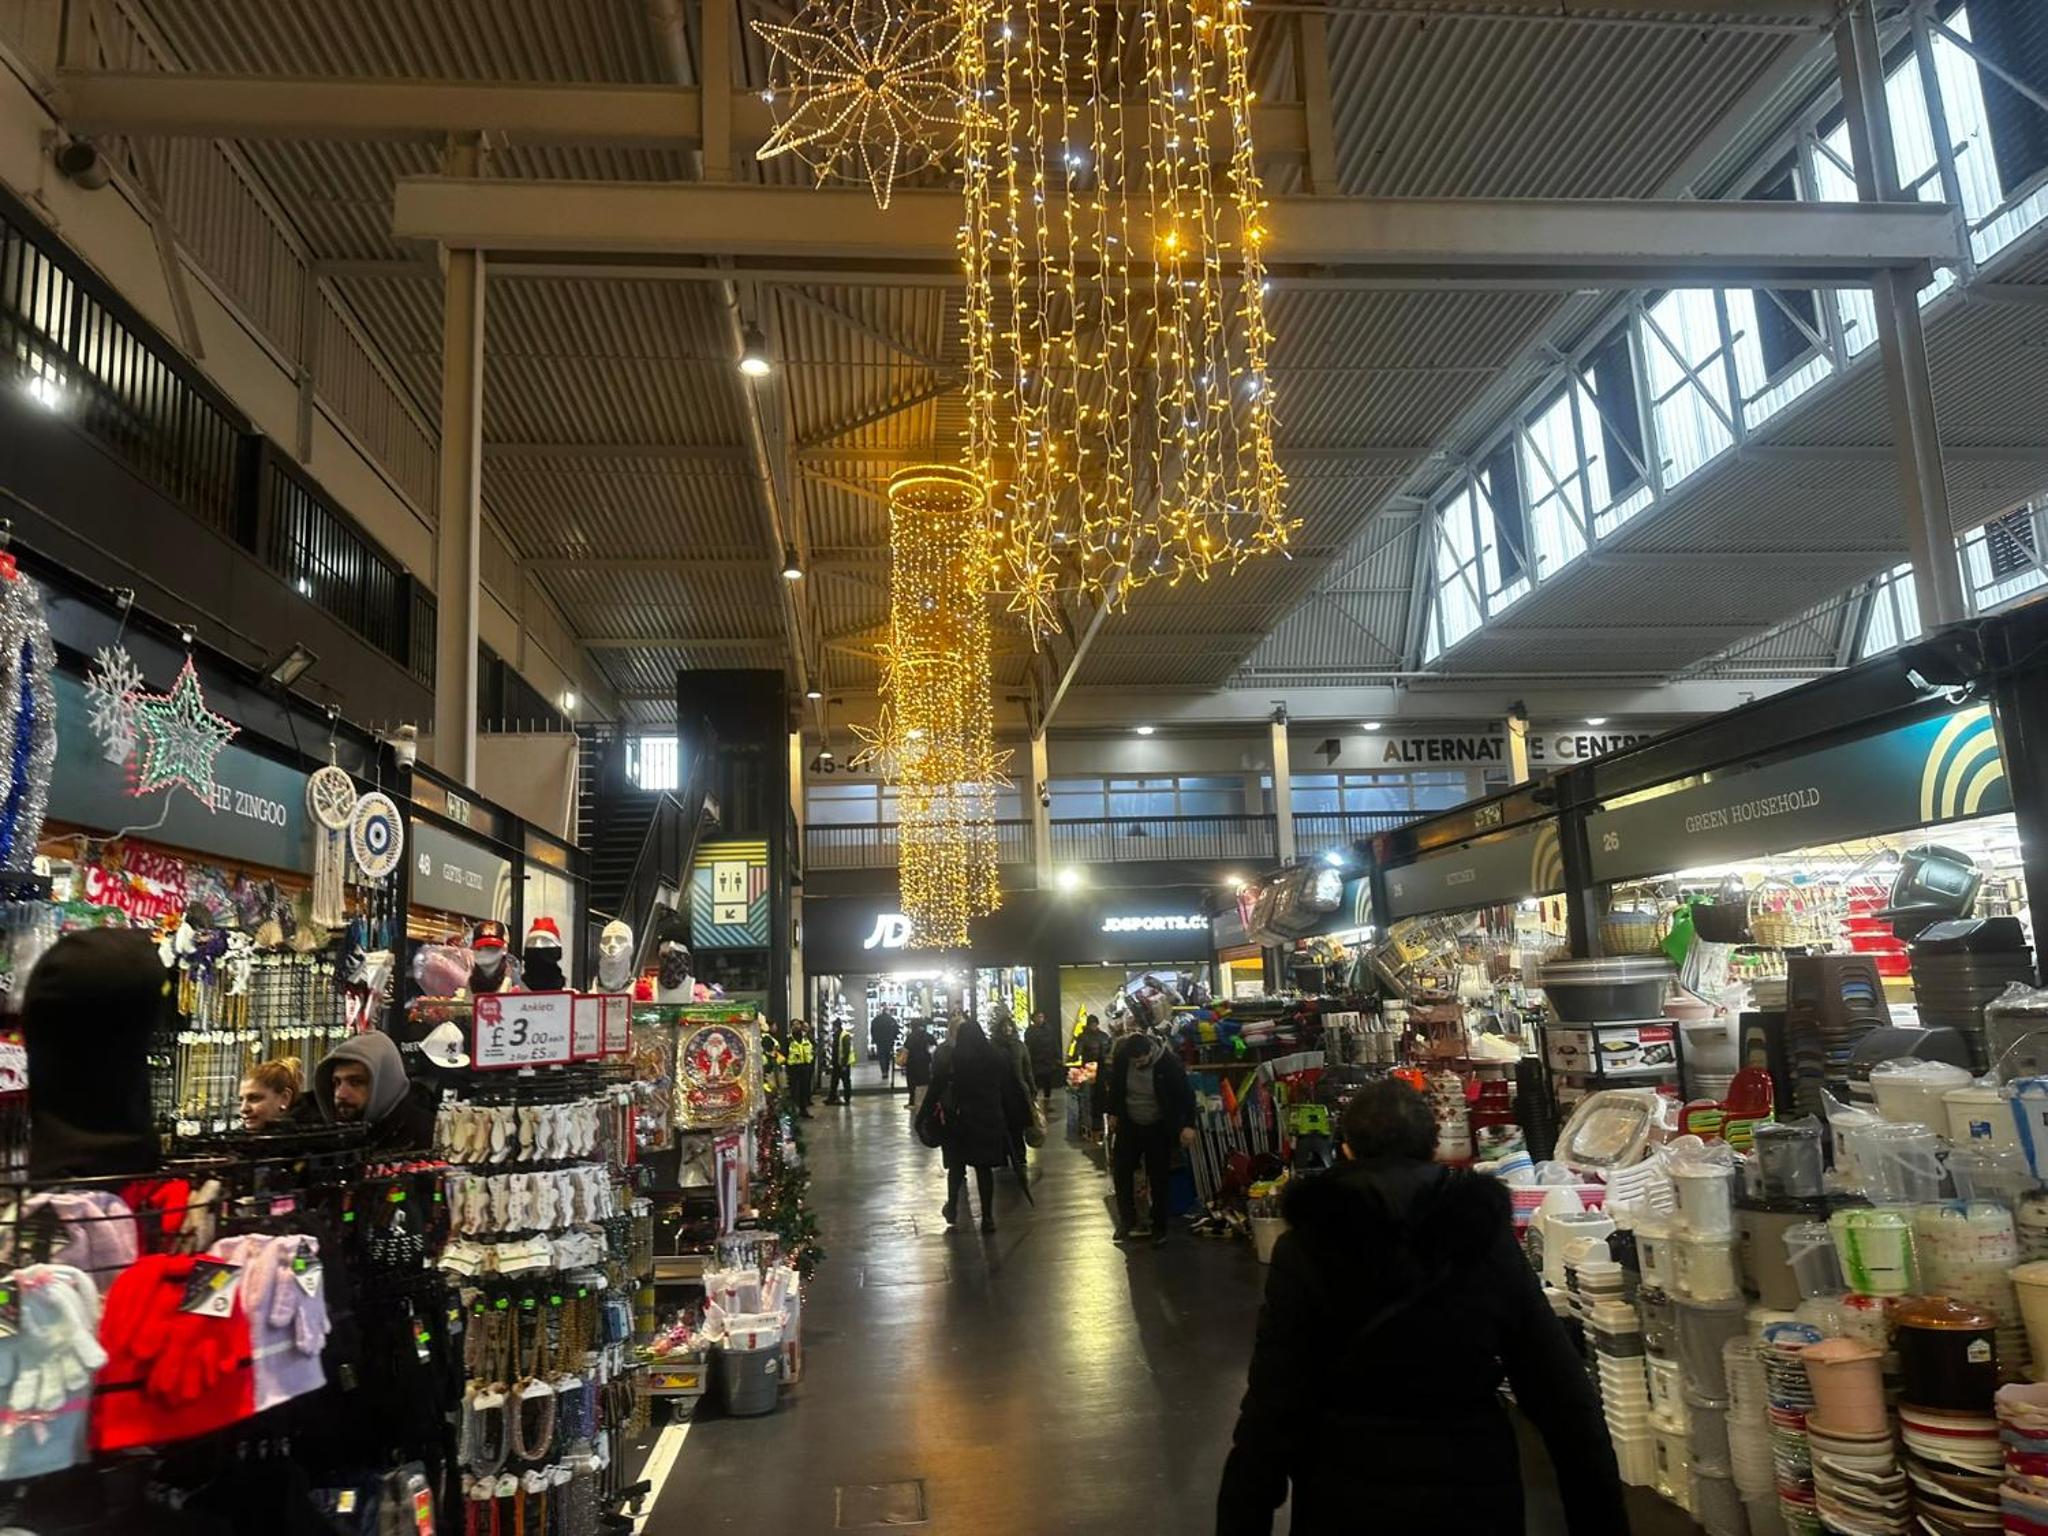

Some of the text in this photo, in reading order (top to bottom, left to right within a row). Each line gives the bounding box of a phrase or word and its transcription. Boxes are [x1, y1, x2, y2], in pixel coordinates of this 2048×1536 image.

[1383, 737, 1544, 762] ALTERNATE
[235, 790, 286, 826] ZINGOO
[1685, 787, 1820, 833] GREEN HOUSEHOLD
[1602, 832, 1620, 851] 26
[863, 913, 912, 950] JD
